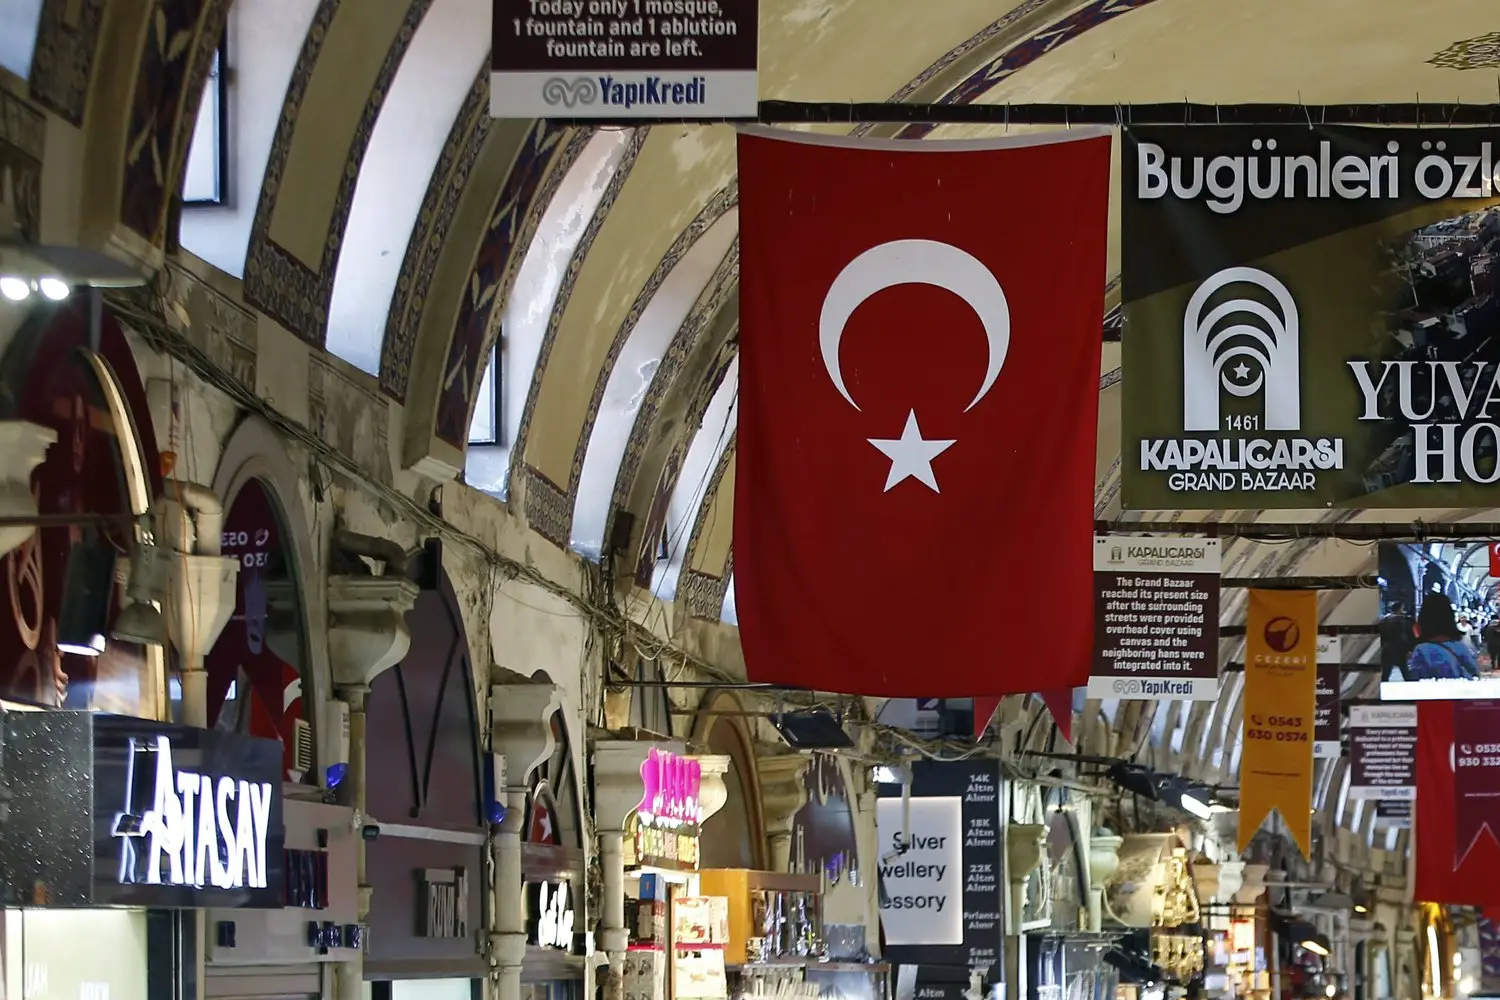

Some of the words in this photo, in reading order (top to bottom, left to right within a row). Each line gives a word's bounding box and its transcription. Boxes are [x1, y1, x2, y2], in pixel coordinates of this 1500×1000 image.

[529, 0, 581, 18] Today
[590, 0, 627, 18] only
[634, 0, 642, 15] 1
[646, 0, 723, 17] mosque,
[513, 20, 520, 36] 1
[526, 19, 604, 36] fountain
[609, 19, 643, 36] and
[649, 20, 656, 36] 1
[660, 19, 737, 36] ablution
[547, 39, 625, 57] fountain
[630, 42, 661, 57] are
[666, 39, 703, 57] left.
[1138, 141, 1399, 213] Bugünleri
[1226, 415, 1259, 431] 1461
[1169, 472, 1236, 491] GRAND
[1242, 472, 1316, 491] BAZAAR
[1116, 577, 1133, 587] The
[1135, 577, 1162, 587] Grand
[1164, 578, 1195, 588] Bazaar
[1102, 589, 1138, 599] reached
[1140, 589, 1152, 599] its
[1154, 590, 1189, 600] present
[1191, 590, 1209, 600] size
[1106, 602, 1129, 611] after
[1131, 602, 1146, 611] the
[1148, 602, 1203, 613] surrounding
[1105, 613, 1138, 622] streets
[1139, 614, 1163, 622] were
[1164, 613, 1204, 624] provided
[1106, 625, 1148, 634] overhead
[1150, 626, 1176, 635] cover
[1177, 626, 1202, 637] using
[1120, 638, 1152, 646] canvas
[1153, 637, 1170, 646] and
[1172, 637, 1188, 646] the
[1102, 648, 1156, 659] neighboring
[1158, 649, 1180, 659] hans
[1182, 650, 1205, 659] were
[1114, 660, 1162, 671] integrated
[1163, 660, 1181, 670] into
[1183, 661, 1193, 670] it.
[969, 774, 990, 782] 14K
[136, 735, 273, 889] ATASAY
[970, 819, 990, 827] 18K
[892, 832, 946, 850] Slver
[880, 861, 946, 882] wellery
[970, 864, 992, 873] 22K
[881, 895, 946, 912] essory
